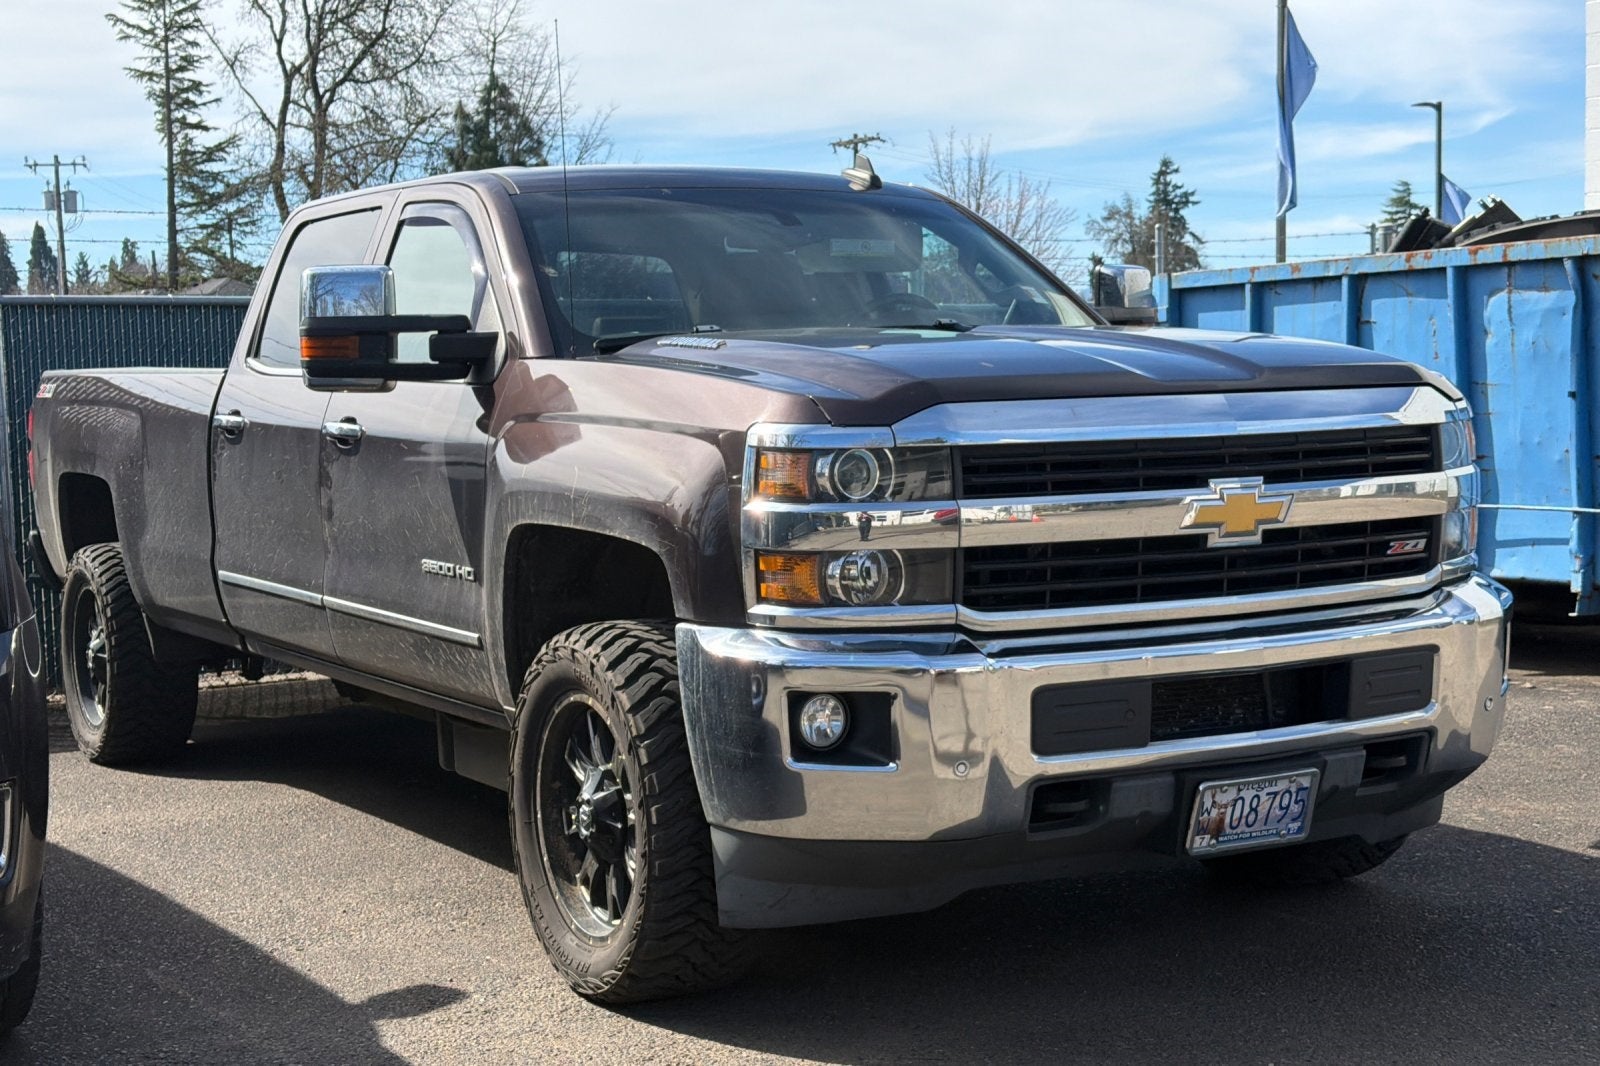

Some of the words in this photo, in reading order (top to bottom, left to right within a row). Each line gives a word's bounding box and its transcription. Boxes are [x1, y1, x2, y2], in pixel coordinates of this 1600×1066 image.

[1386, 538, 1427, 554] Z71
[421, 558, 454, 576] 2500
[455, 564, 475, 580] HD
[1229, 787, 1309, 831] 08795
[1219, 834, 1238, 842] WATCH
[1252, 829, 1277, 838] WILDLIFE
